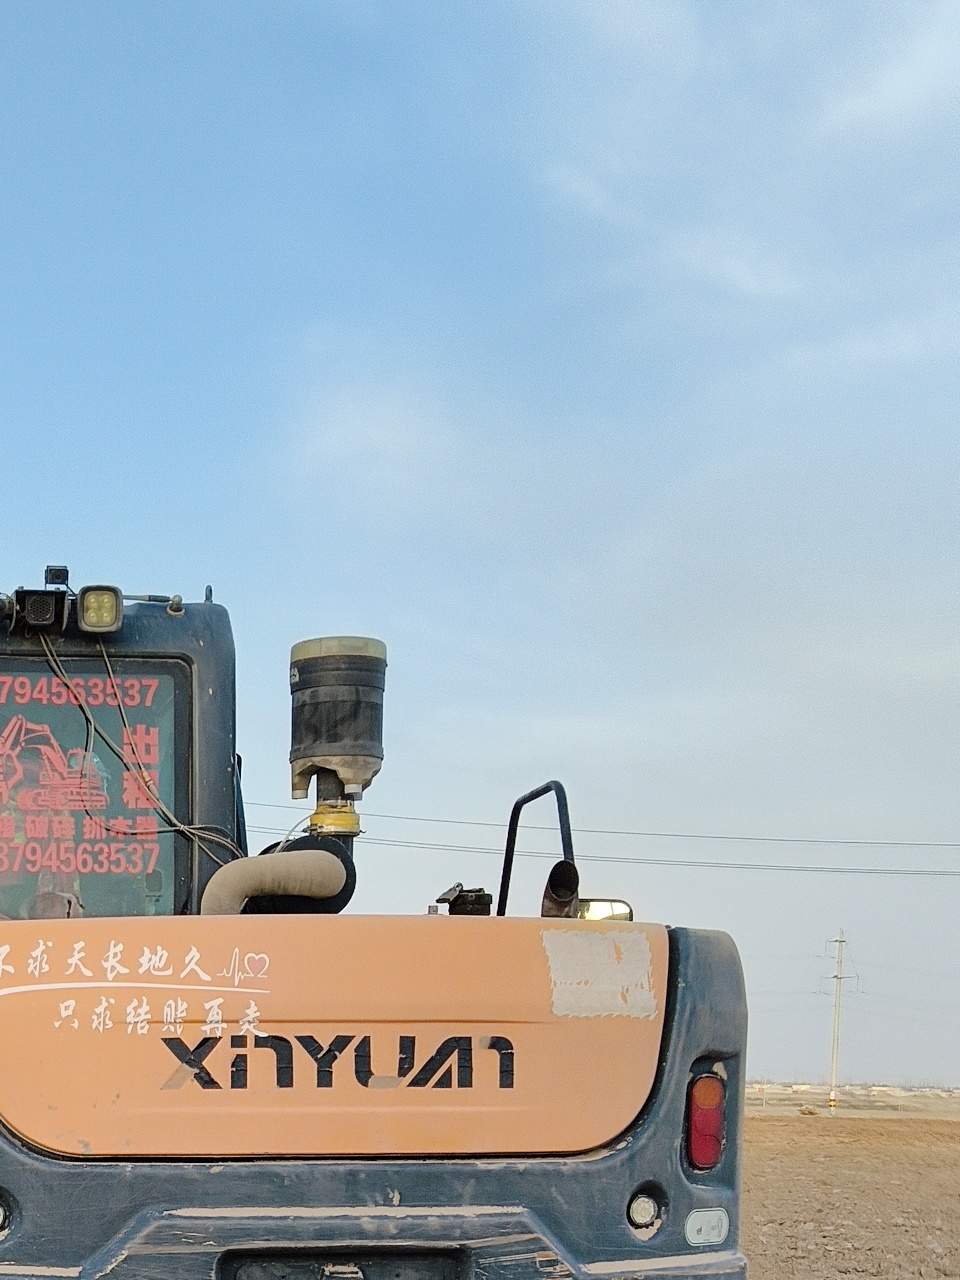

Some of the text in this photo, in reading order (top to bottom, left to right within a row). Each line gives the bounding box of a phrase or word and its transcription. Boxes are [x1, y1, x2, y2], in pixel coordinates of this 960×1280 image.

[54, 997, 269, 1038] 只求结账再走
